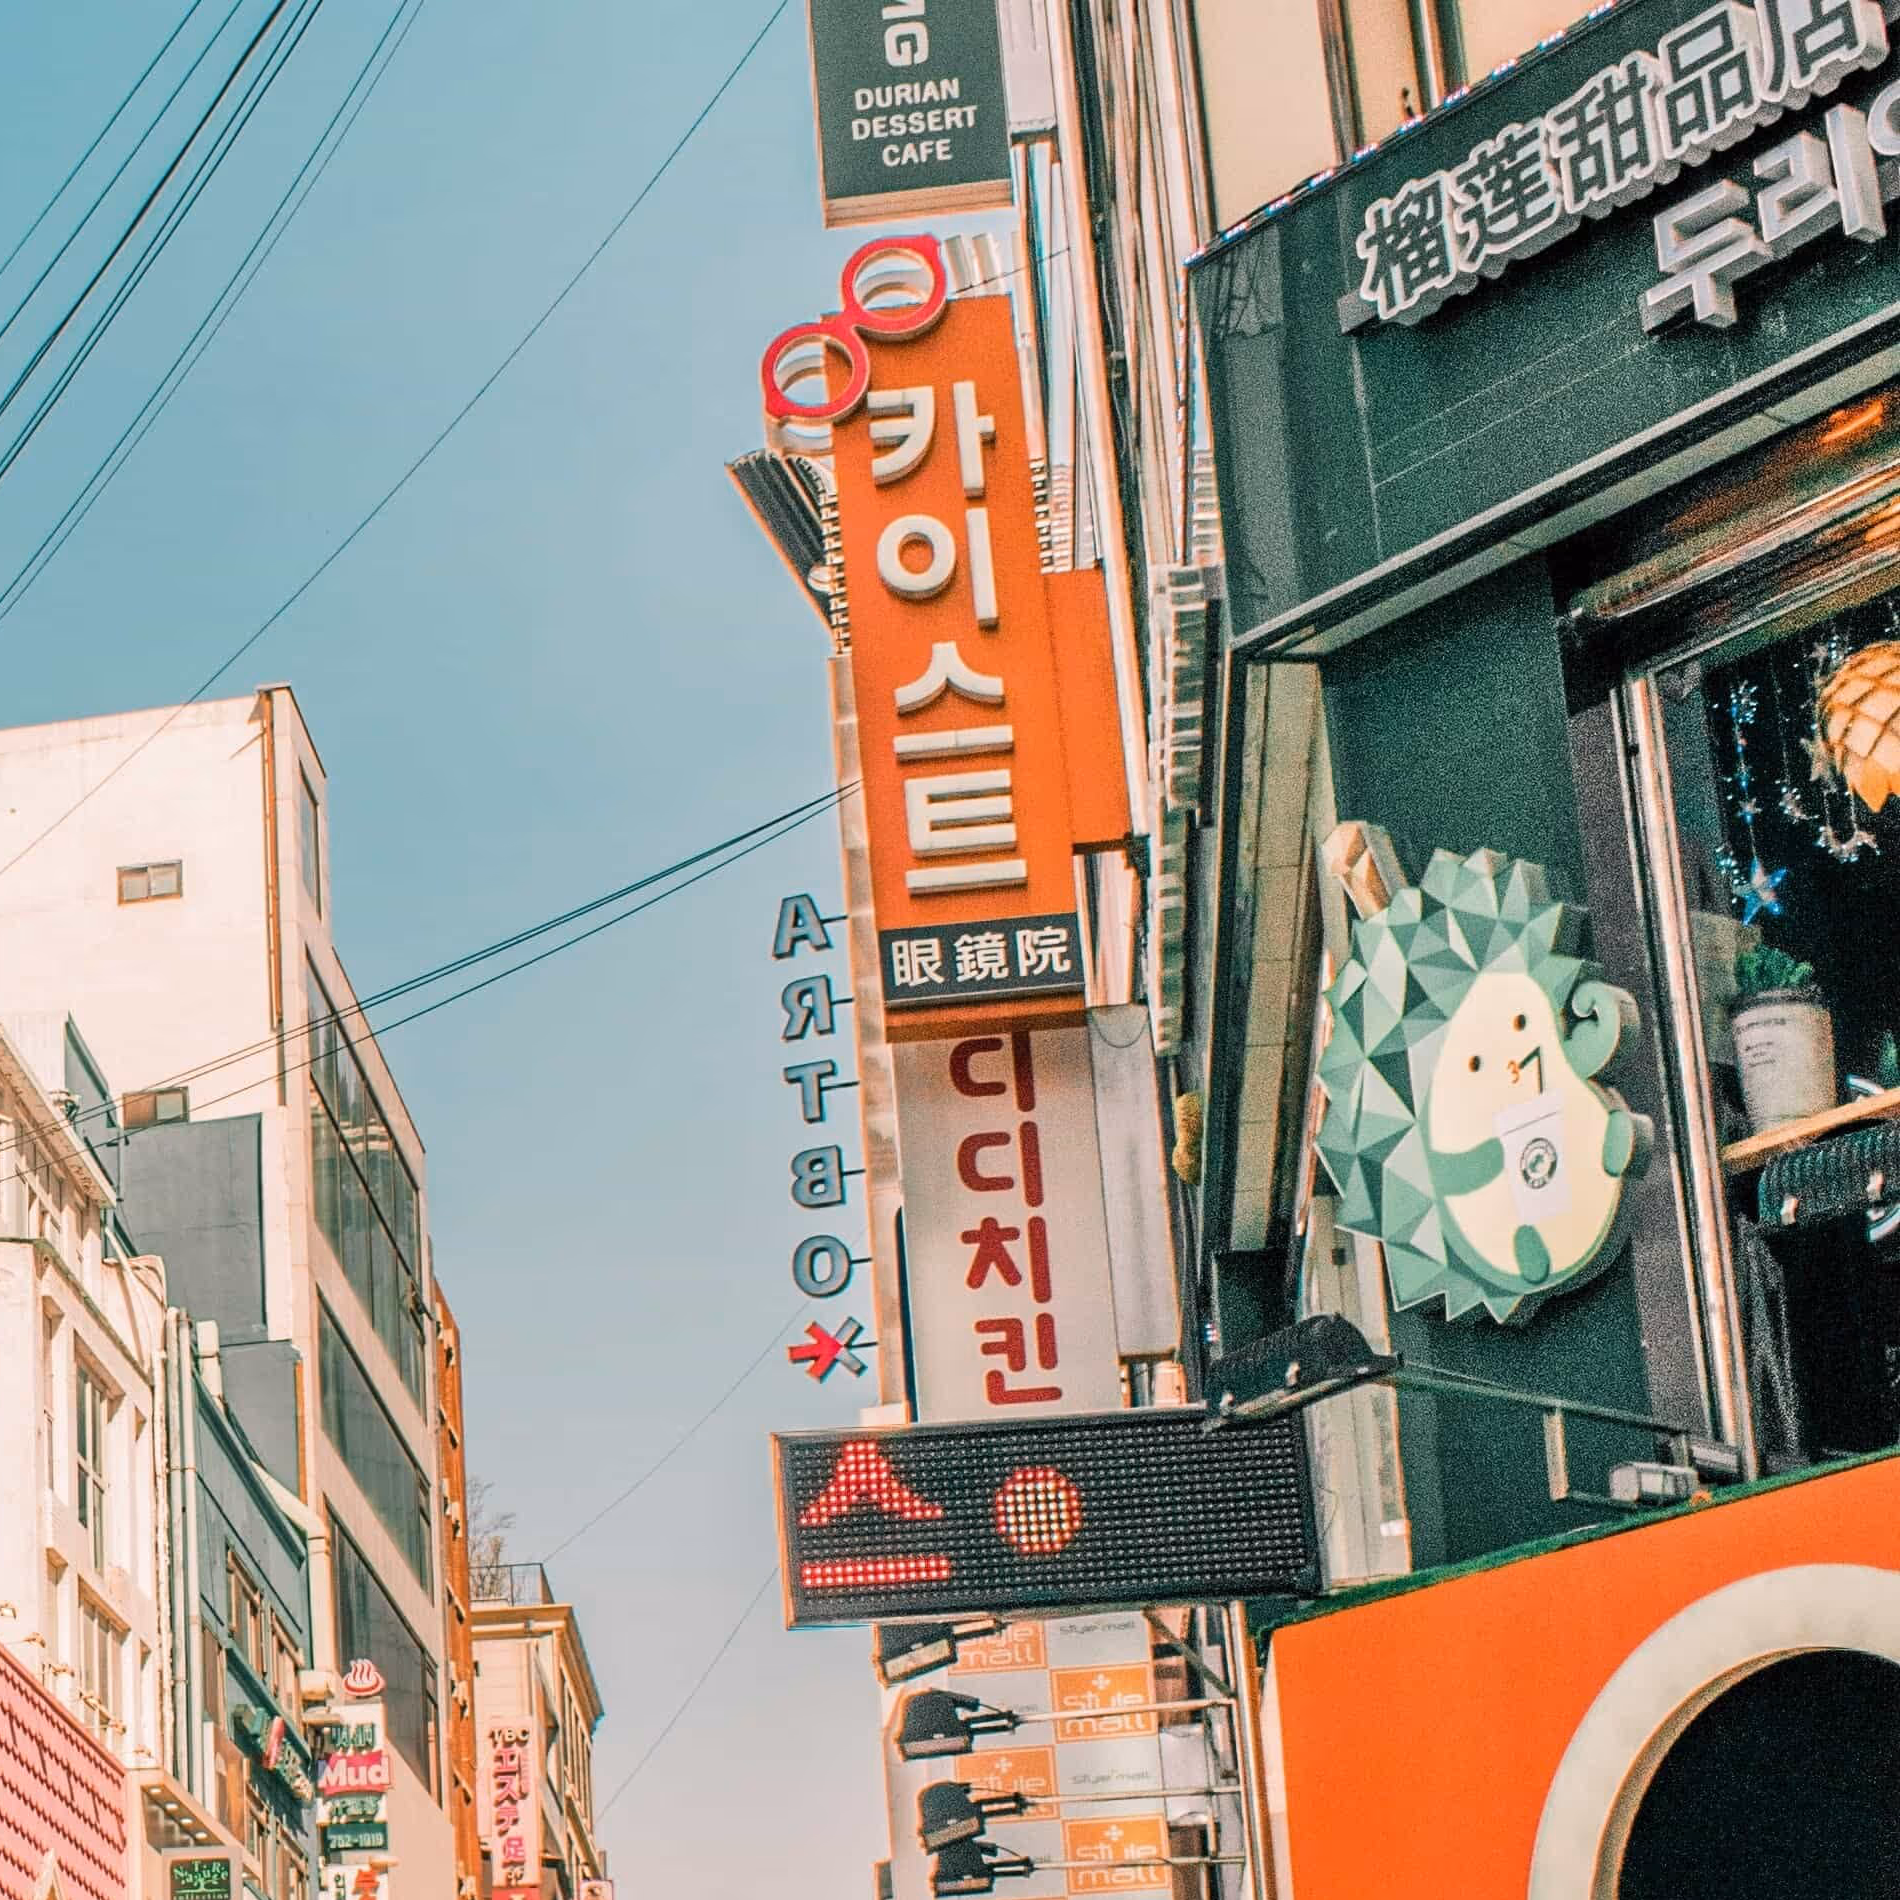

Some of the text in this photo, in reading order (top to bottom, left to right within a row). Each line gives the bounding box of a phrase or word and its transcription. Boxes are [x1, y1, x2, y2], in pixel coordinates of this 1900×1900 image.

[855, 78, 959, 111] DURIAN
[852, 105, 977, 141] DESSERT
[882, 139, 952, 167] CAFE
[867, 381, 1027, 895] 카이스트
[892, 925, 1072, 986] 眼鏡院
[950, 1031, 1063, 1404] 디디치킨
[490, 1727, 530, 1746] TBC
[323, 1757, 390, 1787] Mud
